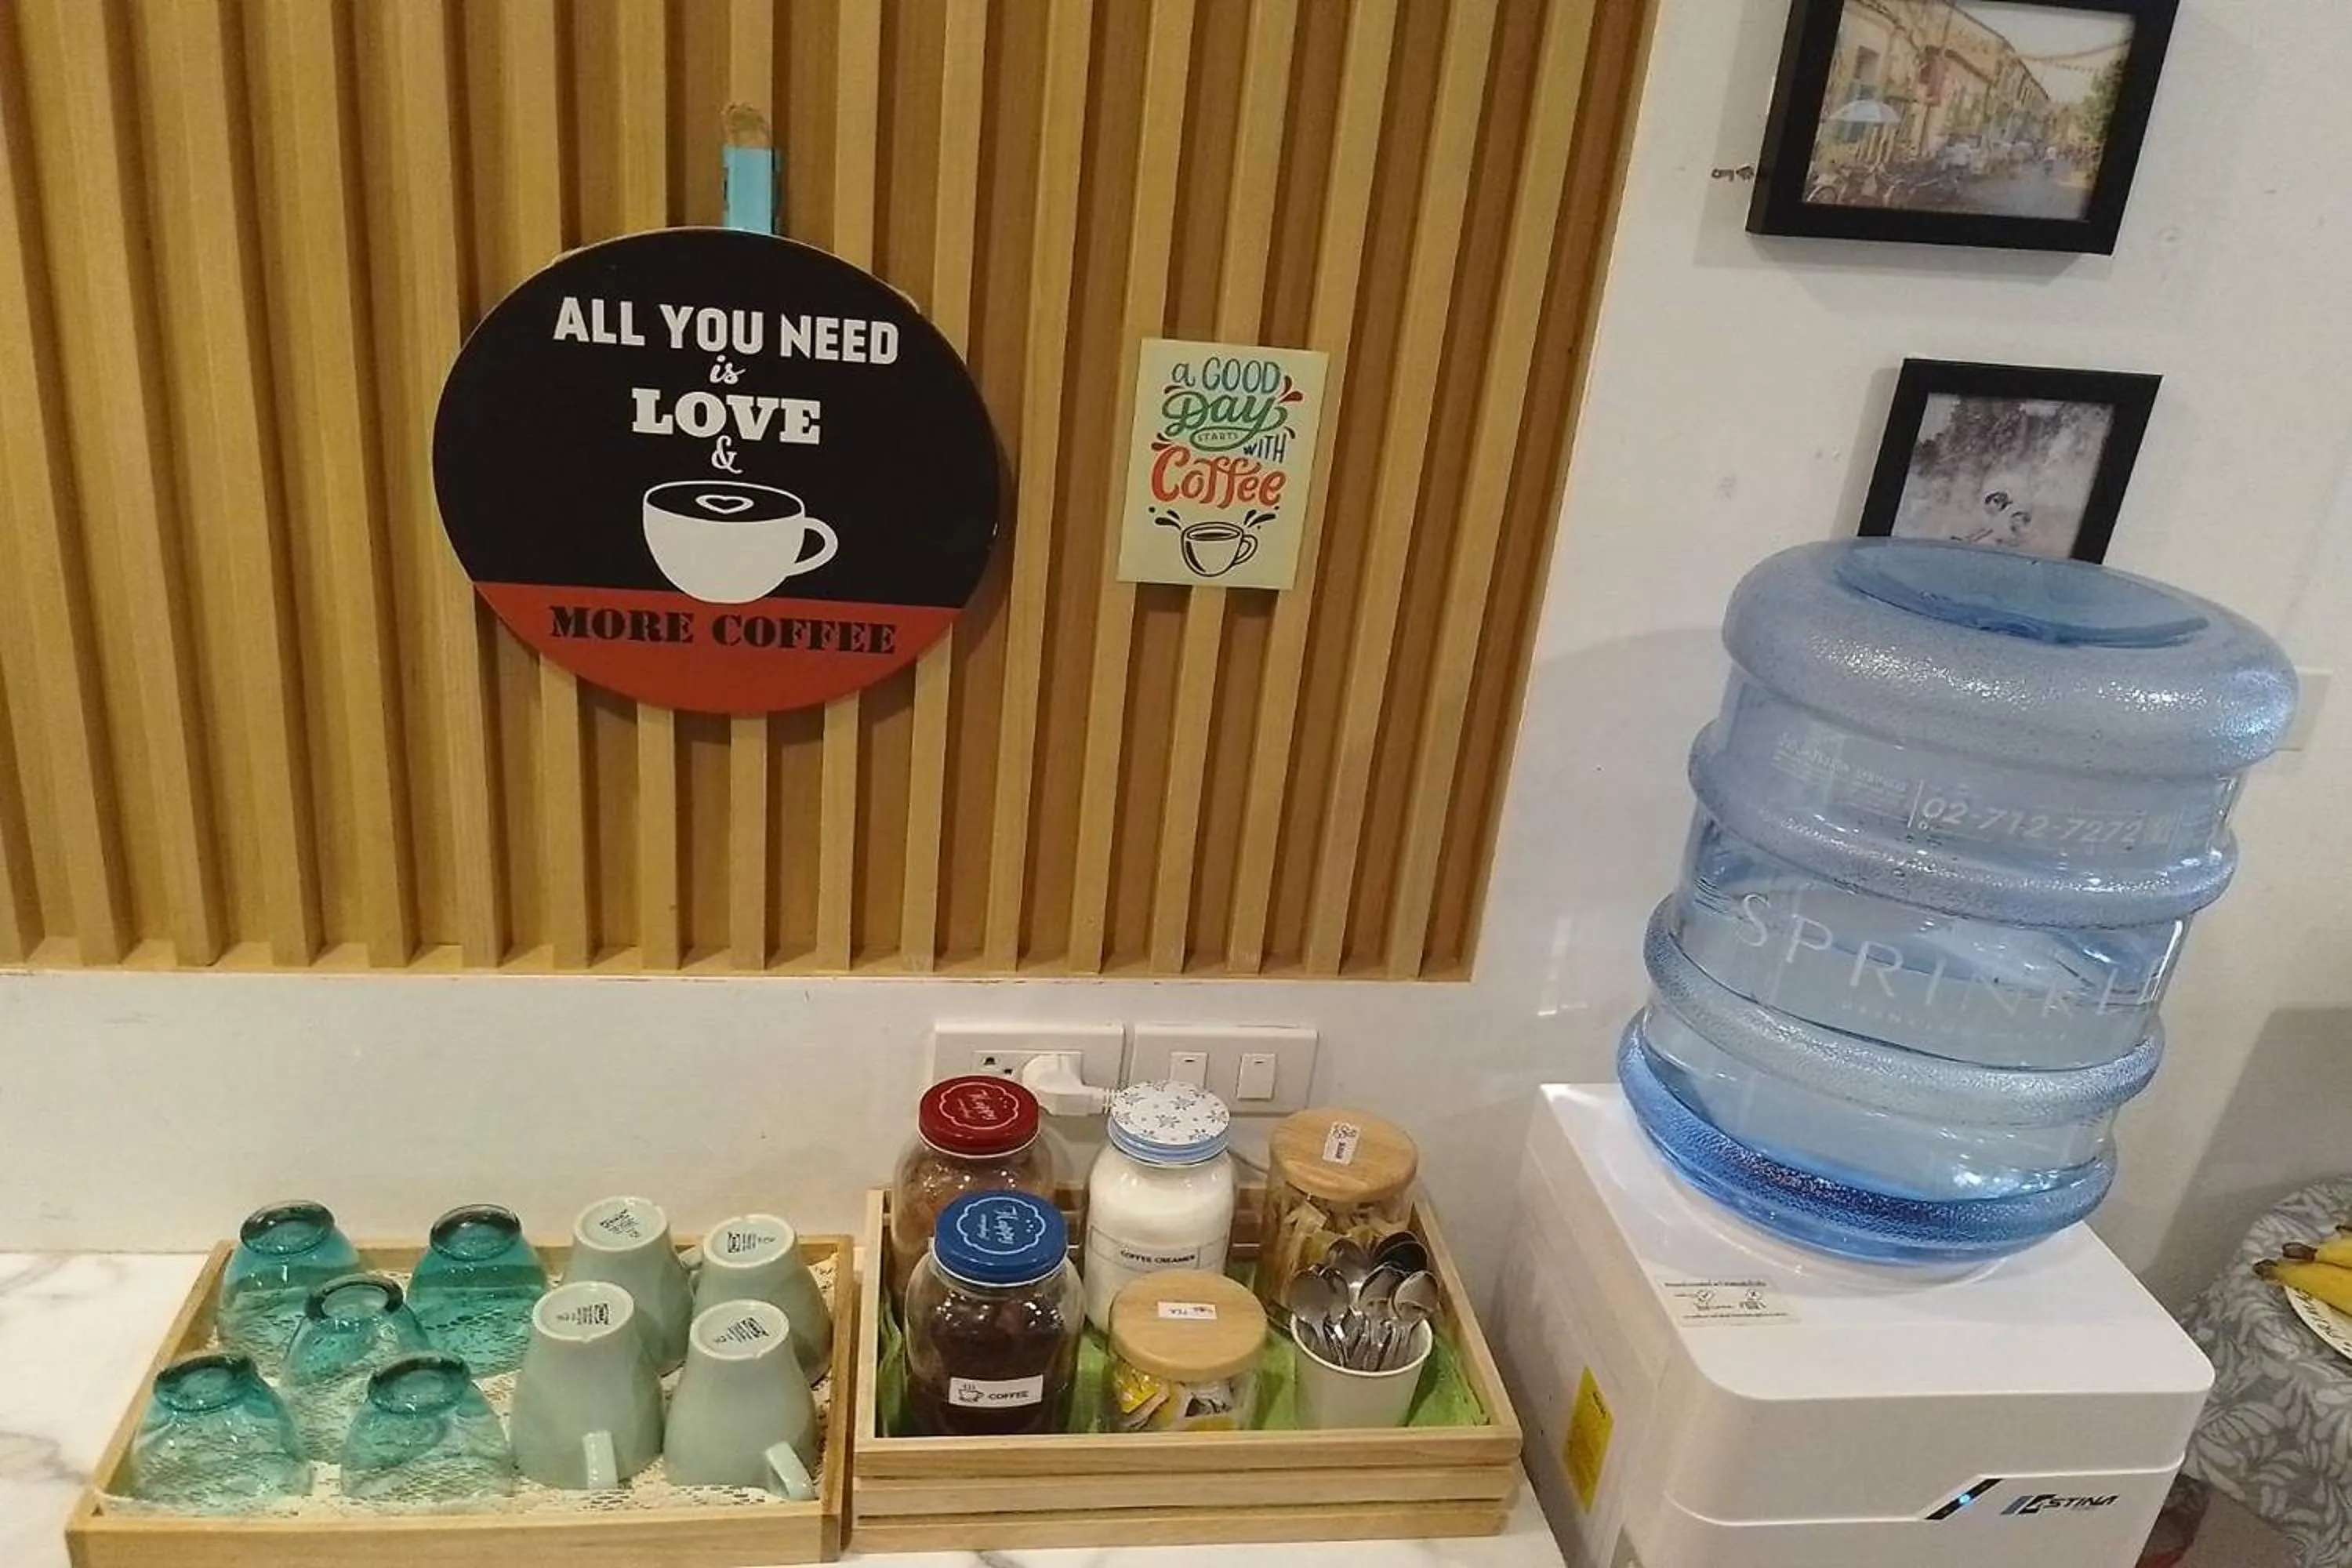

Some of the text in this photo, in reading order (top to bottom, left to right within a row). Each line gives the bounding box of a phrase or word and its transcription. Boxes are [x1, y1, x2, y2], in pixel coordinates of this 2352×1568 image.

[554, 296, 898, 365] ALL YOU NEED
[710, 355, 746, 384] is
[1202, 357, 1281, 394] GOOD
[631, 387, 822, 445] LOVE
[1162, 391, 1288, 451] Day
[711, 435, 742, 474] &
[1197, 432, 1239, 442] STARTS
[1151, 445, 1287, 509] Coffee
[550, 605, 897, 655] MORE COFFEE
[993, 1206, 1018, 1245] Happy
[1121, 1250, 1152, 1263] COFFEE
[988, 1390, 1029, 1401] COFFEE
